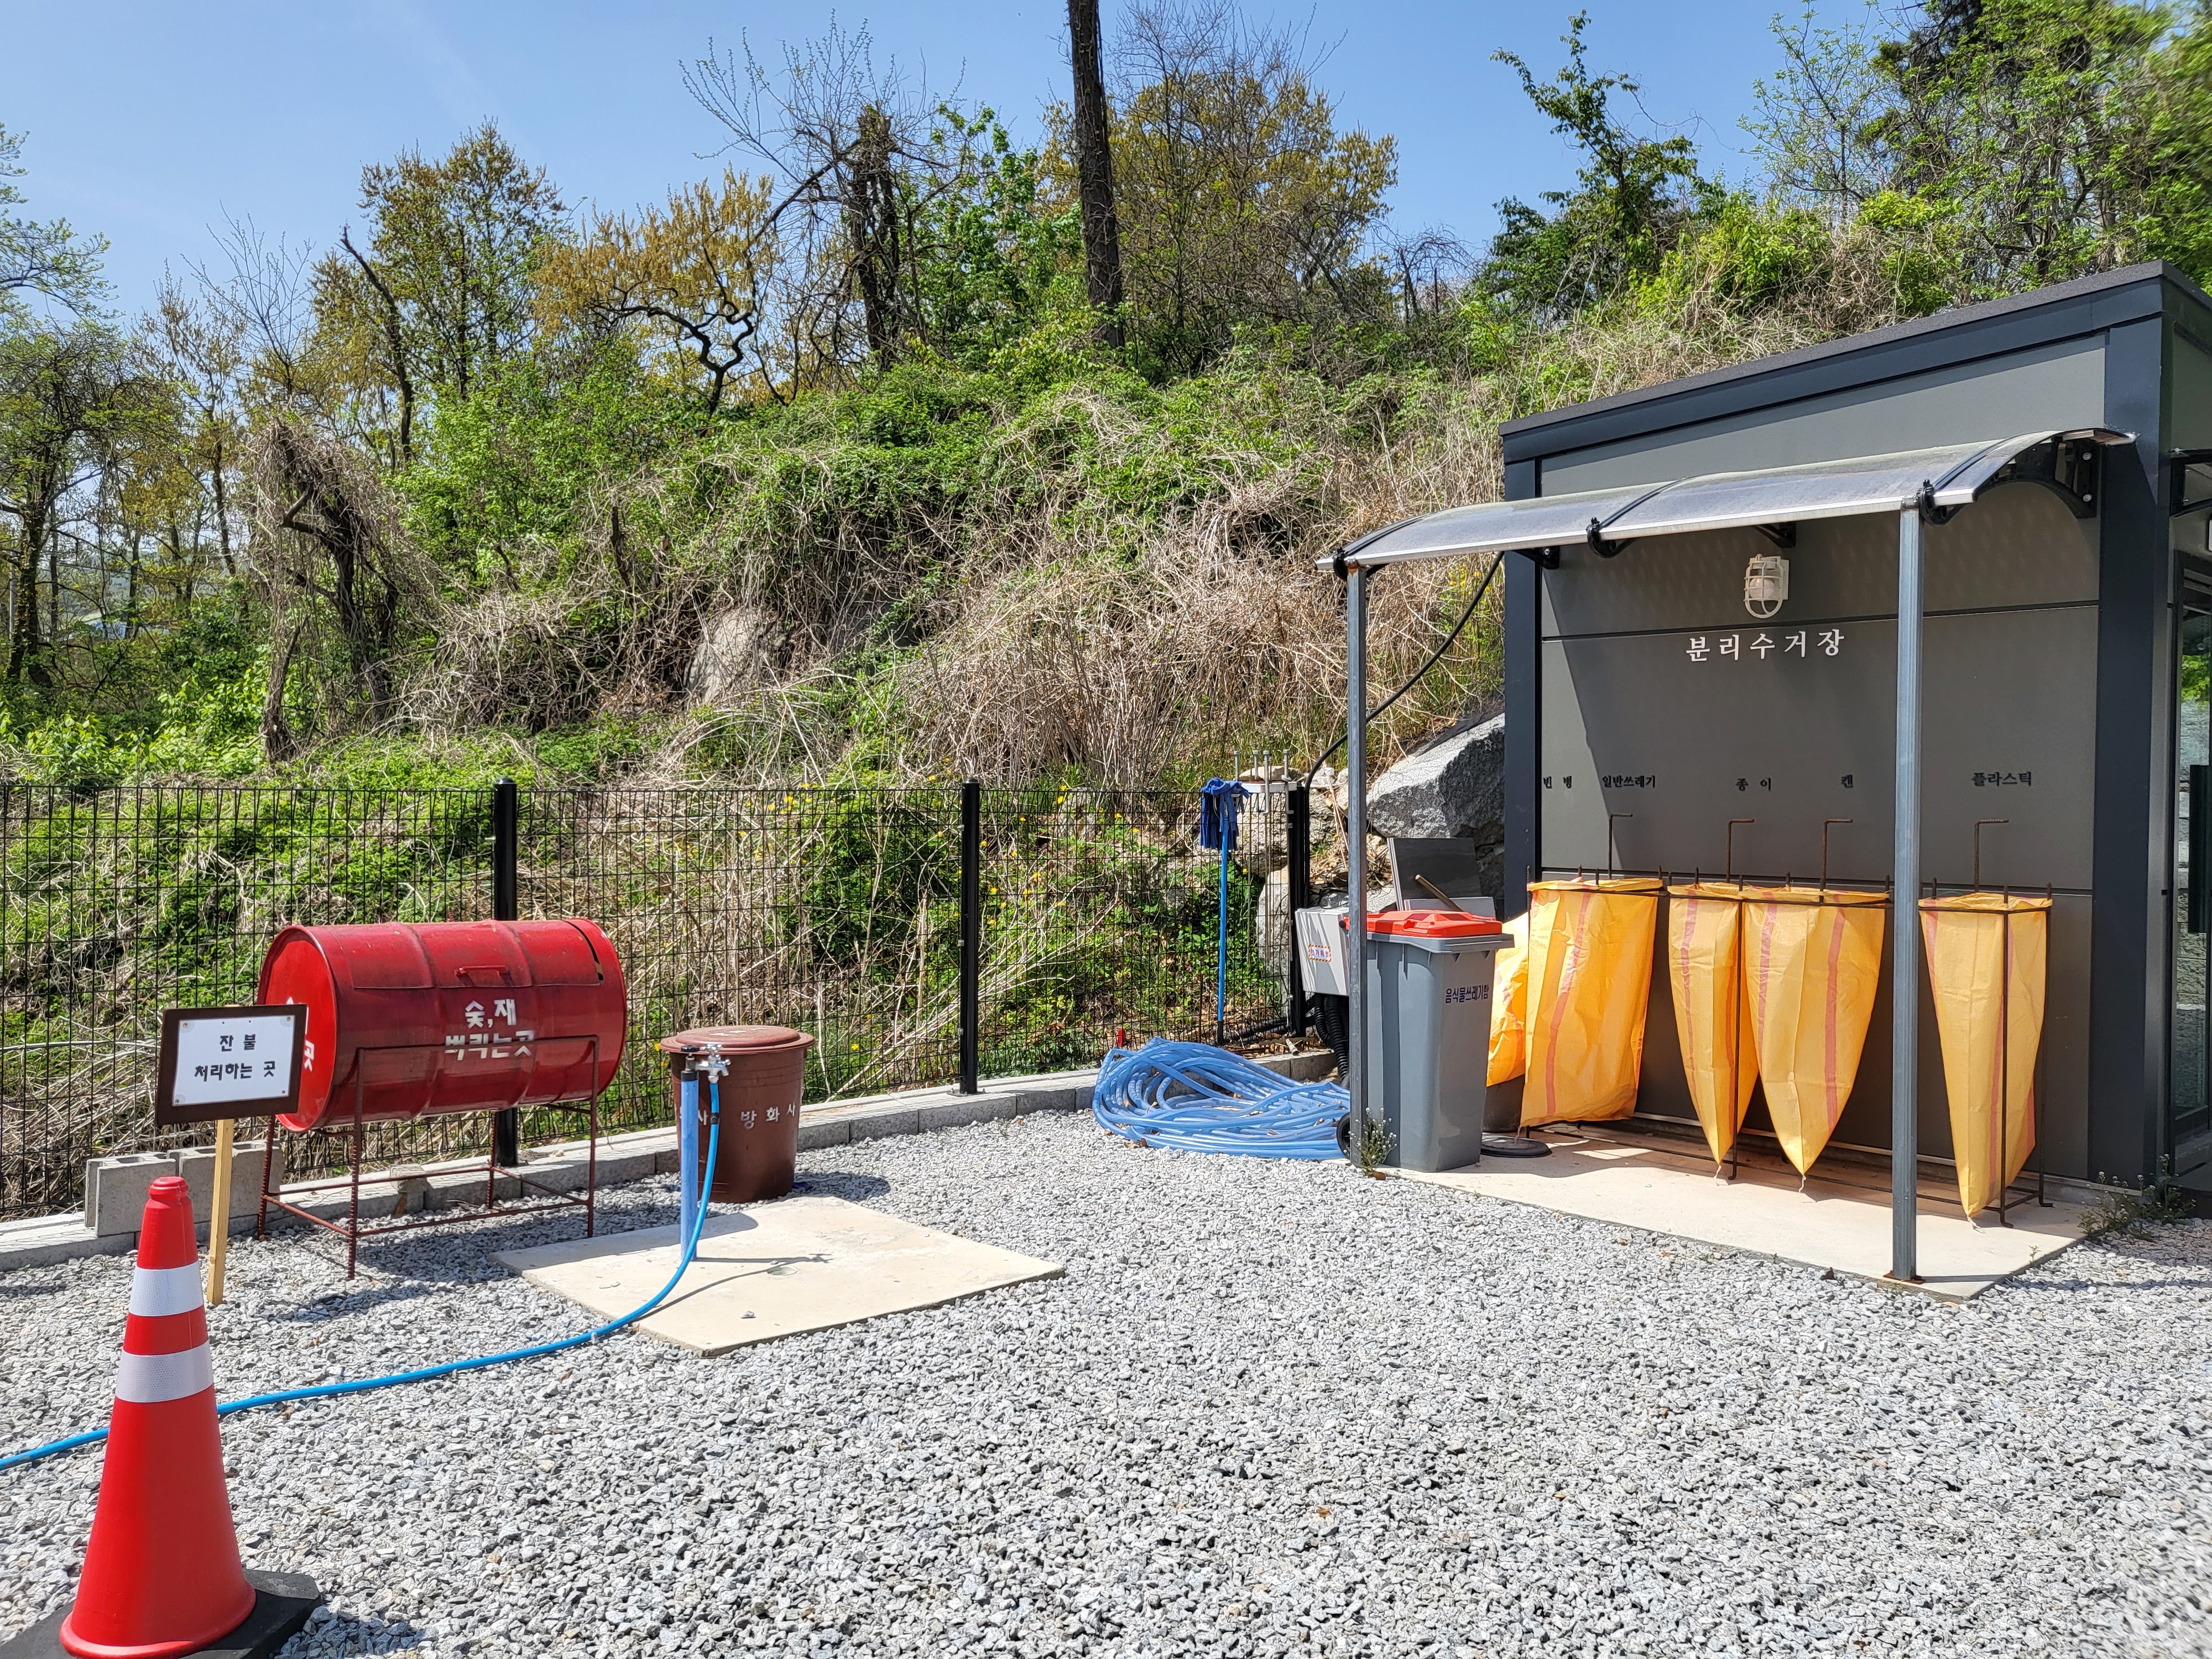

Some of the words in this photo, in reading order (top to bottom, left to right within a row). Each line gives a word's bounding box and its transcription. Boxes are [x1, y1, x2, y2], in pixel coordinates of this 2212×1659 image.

[1686, 629, 1845, 662] 분리수거장
[1602, 775, 1656, 789] 일반쓰레기
[1841, 774, 1854, 788] 캔
[1971, 771, 2031, 786] 플라스틱
[1446, 984, 1489, 1004] 음식물쓰레기함
[194, 1063, 252, 1082] 처리하는
[264, 1061, 276, 1078] 곳
